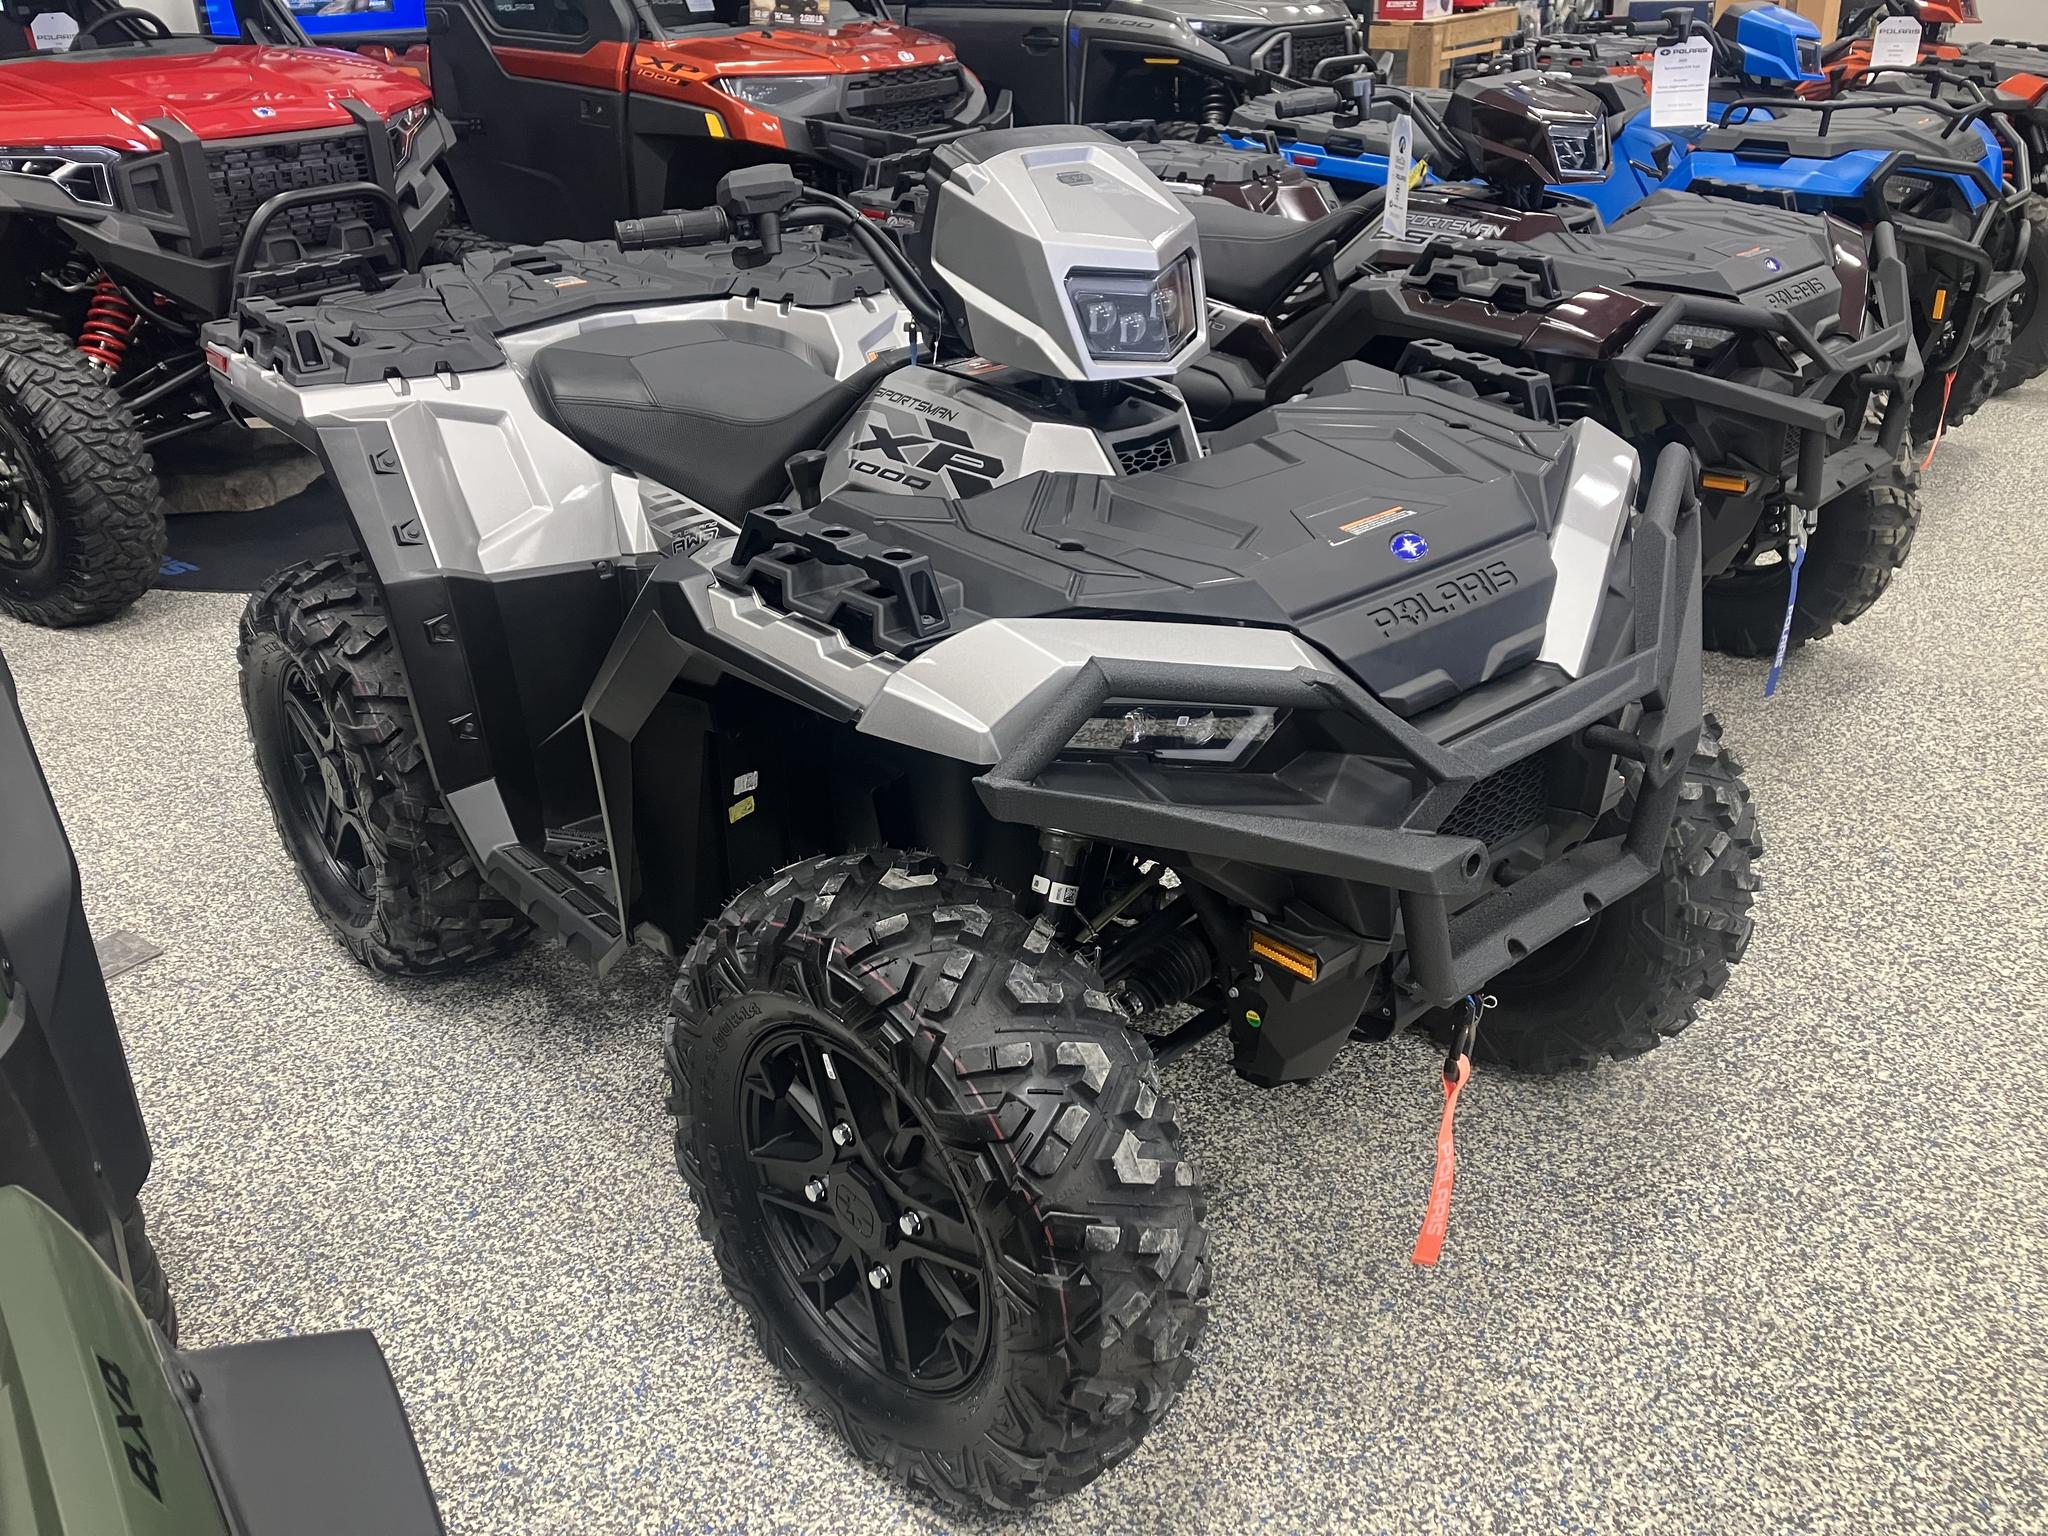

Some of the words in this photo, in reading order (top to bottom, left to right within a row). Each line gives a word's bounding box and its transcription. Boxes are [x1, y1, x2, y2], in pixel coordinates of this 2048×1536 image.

[1098, 18, 1154, 28] 1500
[637, 68, 680, 85] 1000
[641, 55, 700, 73] XP
[1405, 213, 1507, 239] PORTSMAN
[1765, 277, 1826, 308] POLARIS
[874, 387, 960, 422] SPORTSMAN
[849, 423, 1005, 480] XP
[848, 458, 932, 491] 1000
[1367, 560, 1518, 638] POLARIS
[1774, 604, 1795, 668] POLARIS
[1425, 1140, 1454, 1237] POLARIS
